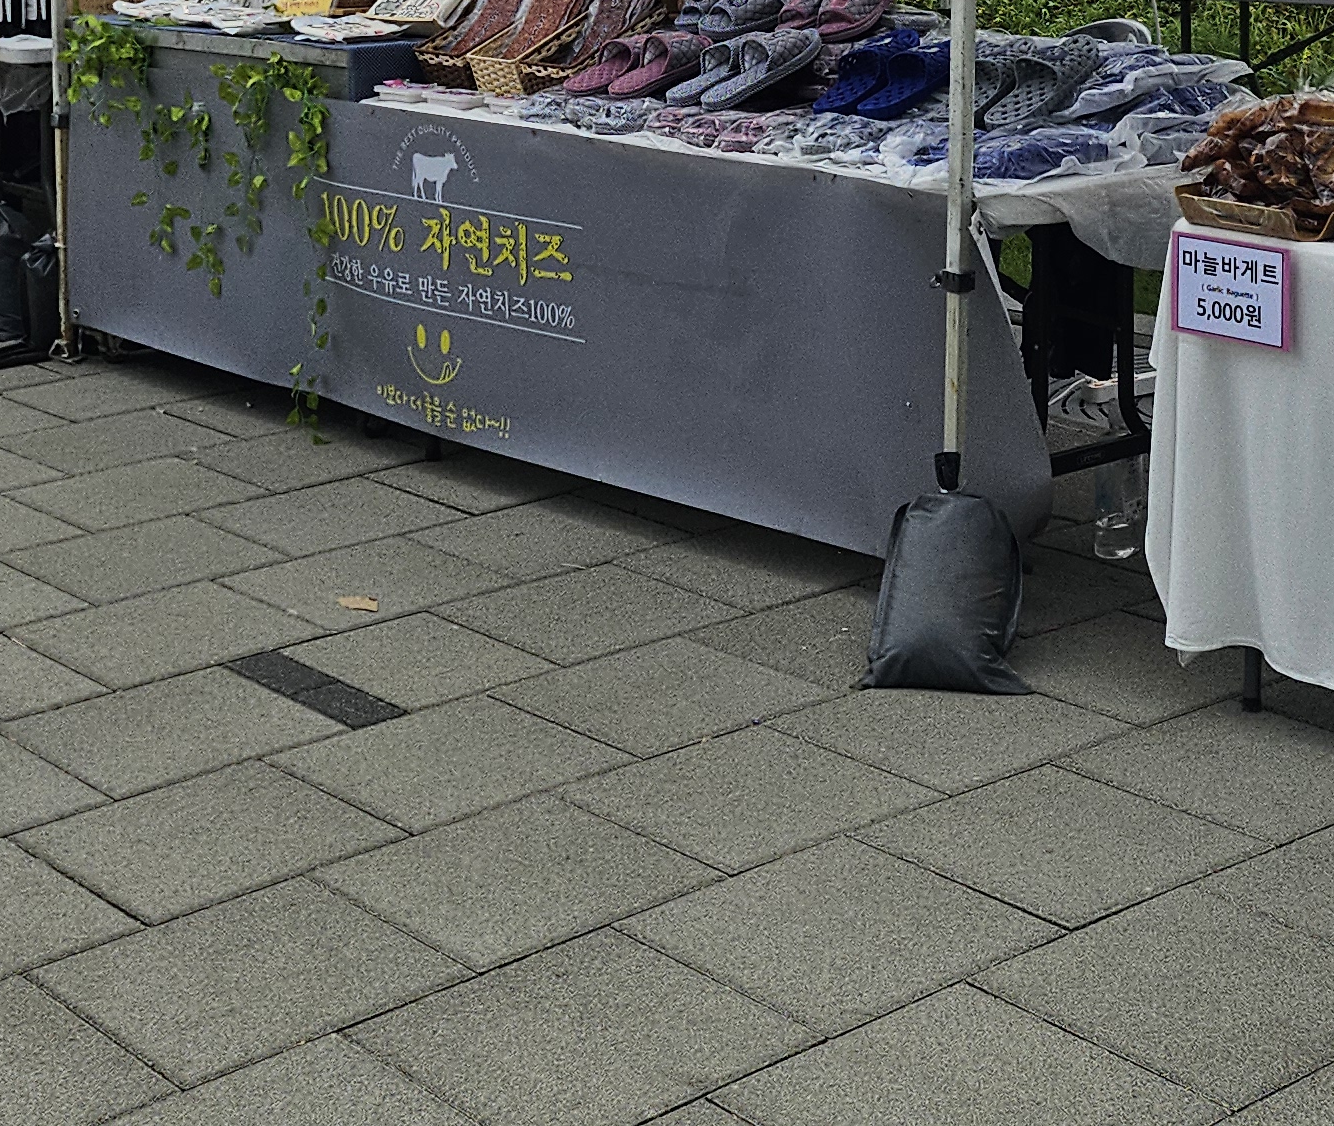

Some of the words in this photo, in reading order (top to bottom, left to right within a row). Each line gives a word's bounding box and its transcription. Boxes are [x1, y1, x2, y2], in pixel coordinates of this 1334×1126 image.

[321, 192, 405, 253] 100%
[420, 208, 574, 286] 자연치즈
[1182, 250, 1279, 285] 마늘바게트
[367, 264, 413, 294] 우유로
[418, 276, 452, 306] 만든
[457, 285, 575, 329] 자연치즈100%
[1196, 297, 1262, 329] 5,000원
[377, 384, 408, 405] 이보다
